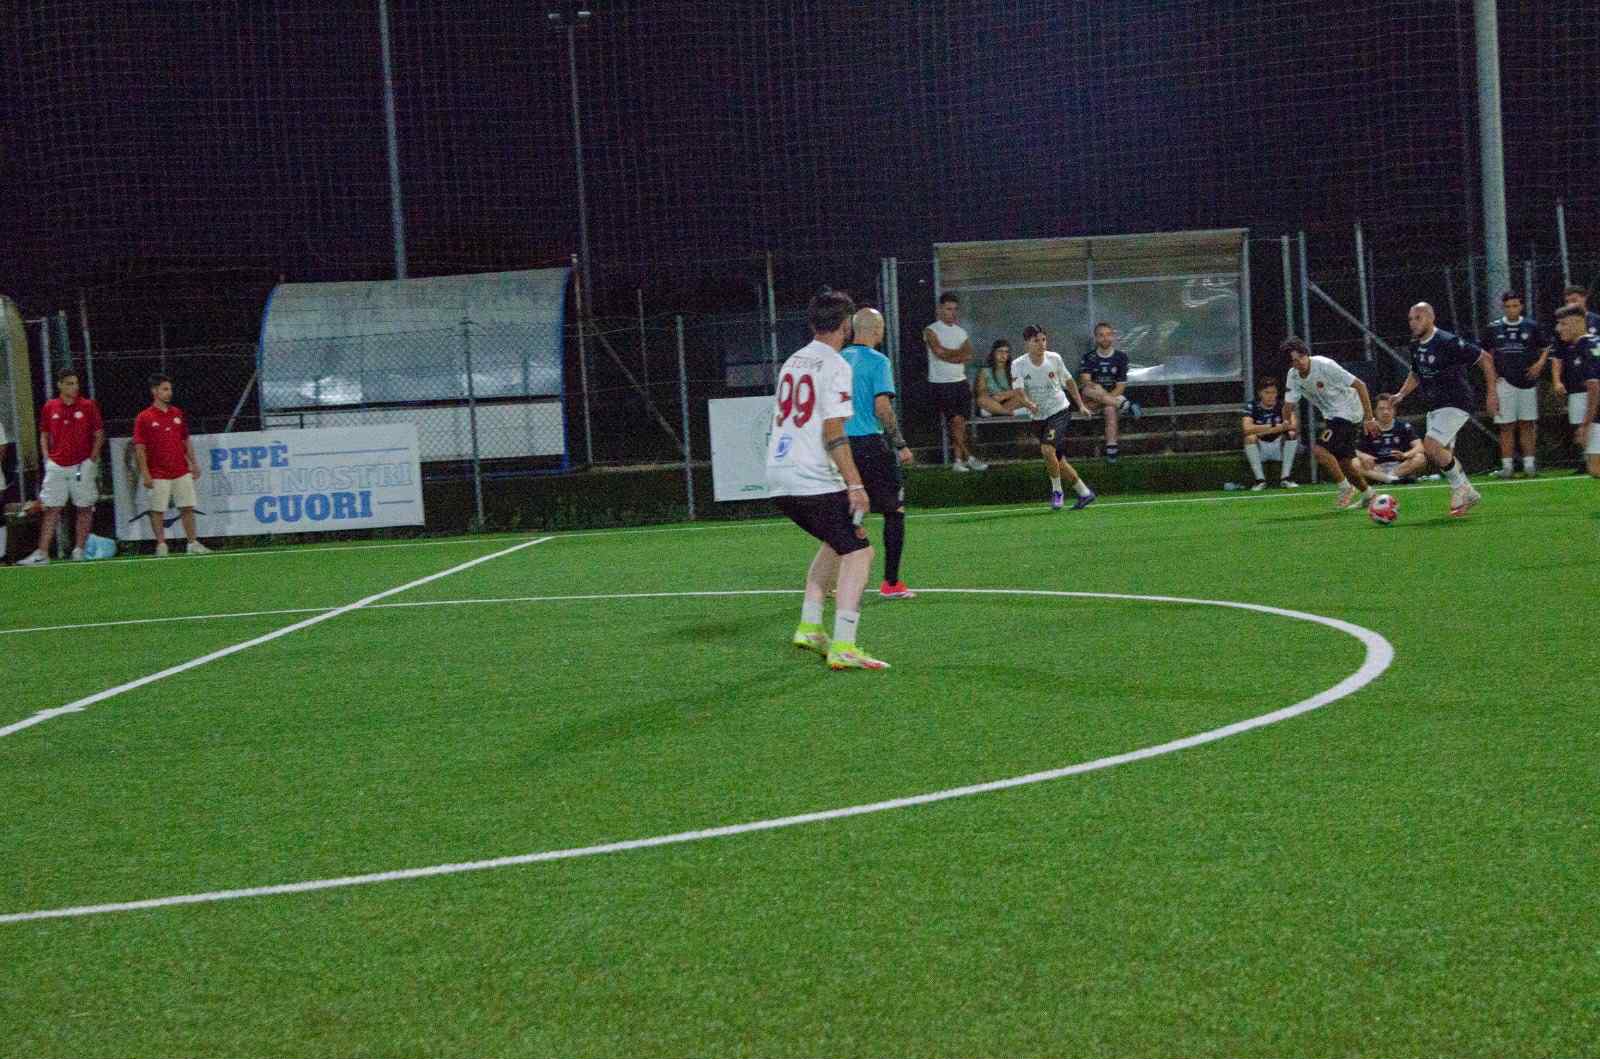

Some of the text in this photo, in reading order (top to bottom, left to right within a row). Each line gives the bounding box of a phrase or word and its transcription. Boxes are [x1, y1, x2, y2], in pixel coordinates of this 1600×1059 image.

[775, 372, 816, 428] 99
[210, 440, 289, 471] PEPÈ
[281, 462, 413, 493] NOSTRI
[254, 490, 373, 524] CUORI
